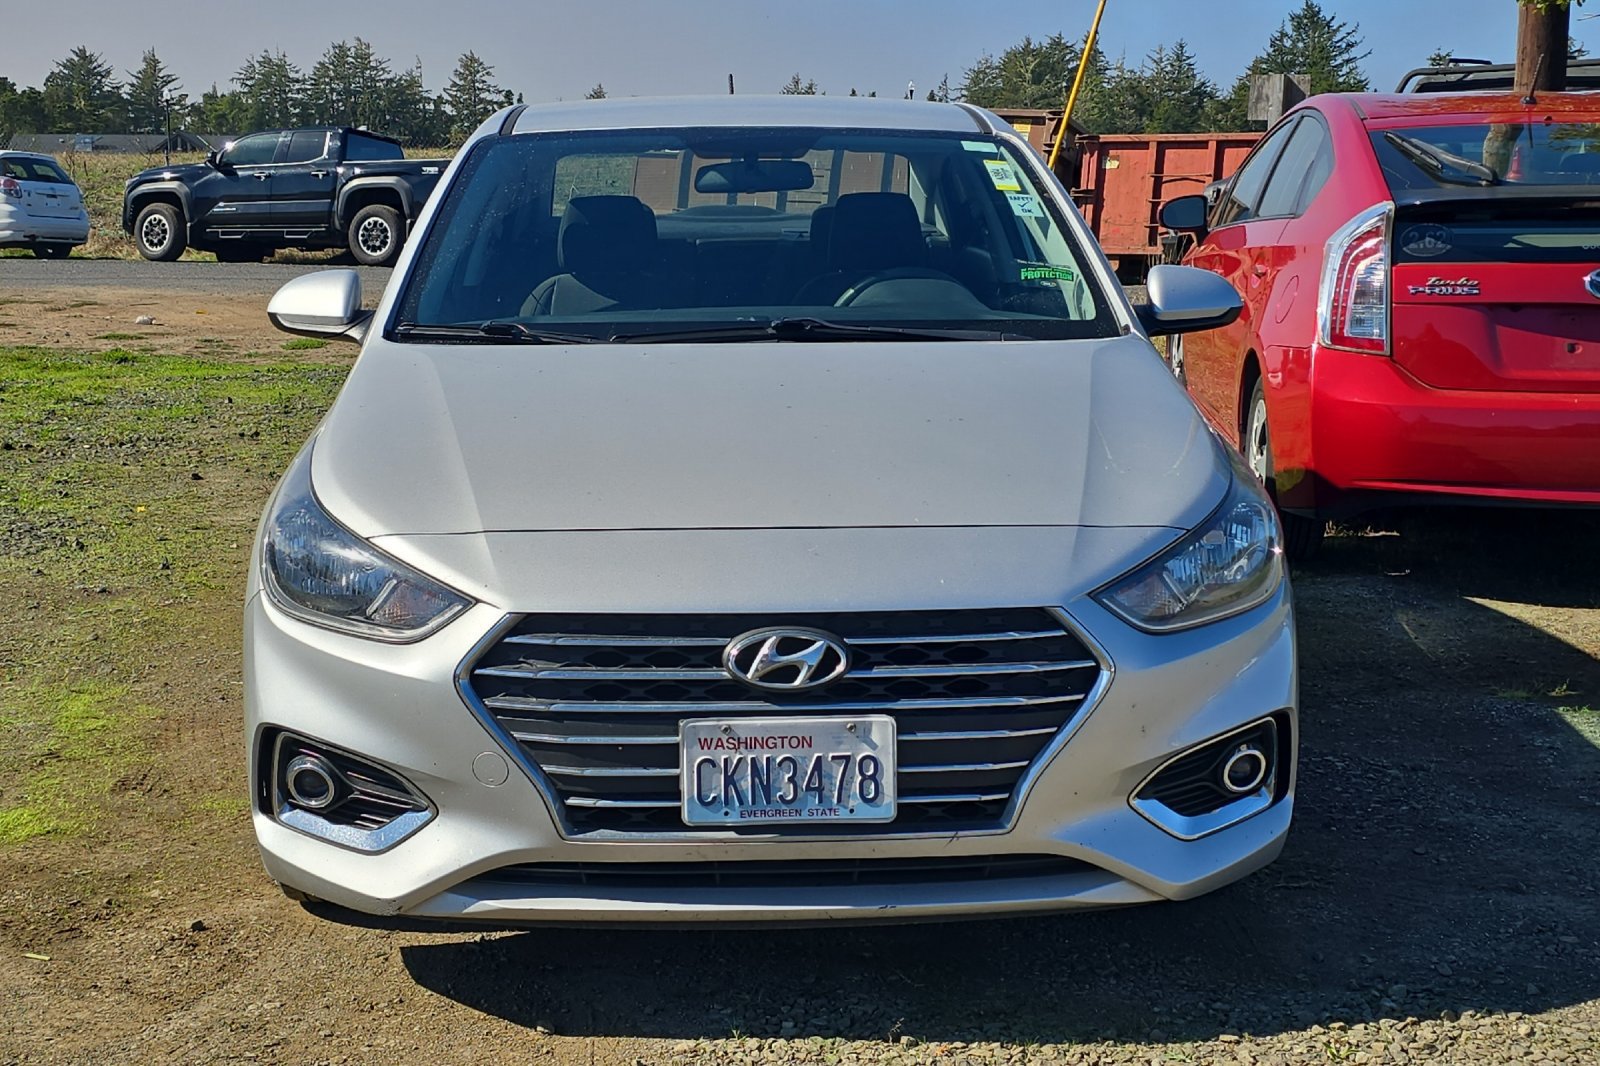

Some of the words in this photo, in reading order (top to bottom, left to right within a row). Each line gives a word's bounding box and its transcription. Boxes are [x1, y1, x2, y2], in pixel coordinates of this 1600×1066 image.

[1021, 270, 1073, 281] PROTECTION
[1426, 276, 1479, 286] Turbo
[1407, 285, 1480, 295] PRIUS
[698, 735, 813, 751] WASHINGTON
[695, 753, 880, 806] CKN3478
[739, 807, 802, 819] EVERGREEN
[807, 806, 841, 817] STATE
